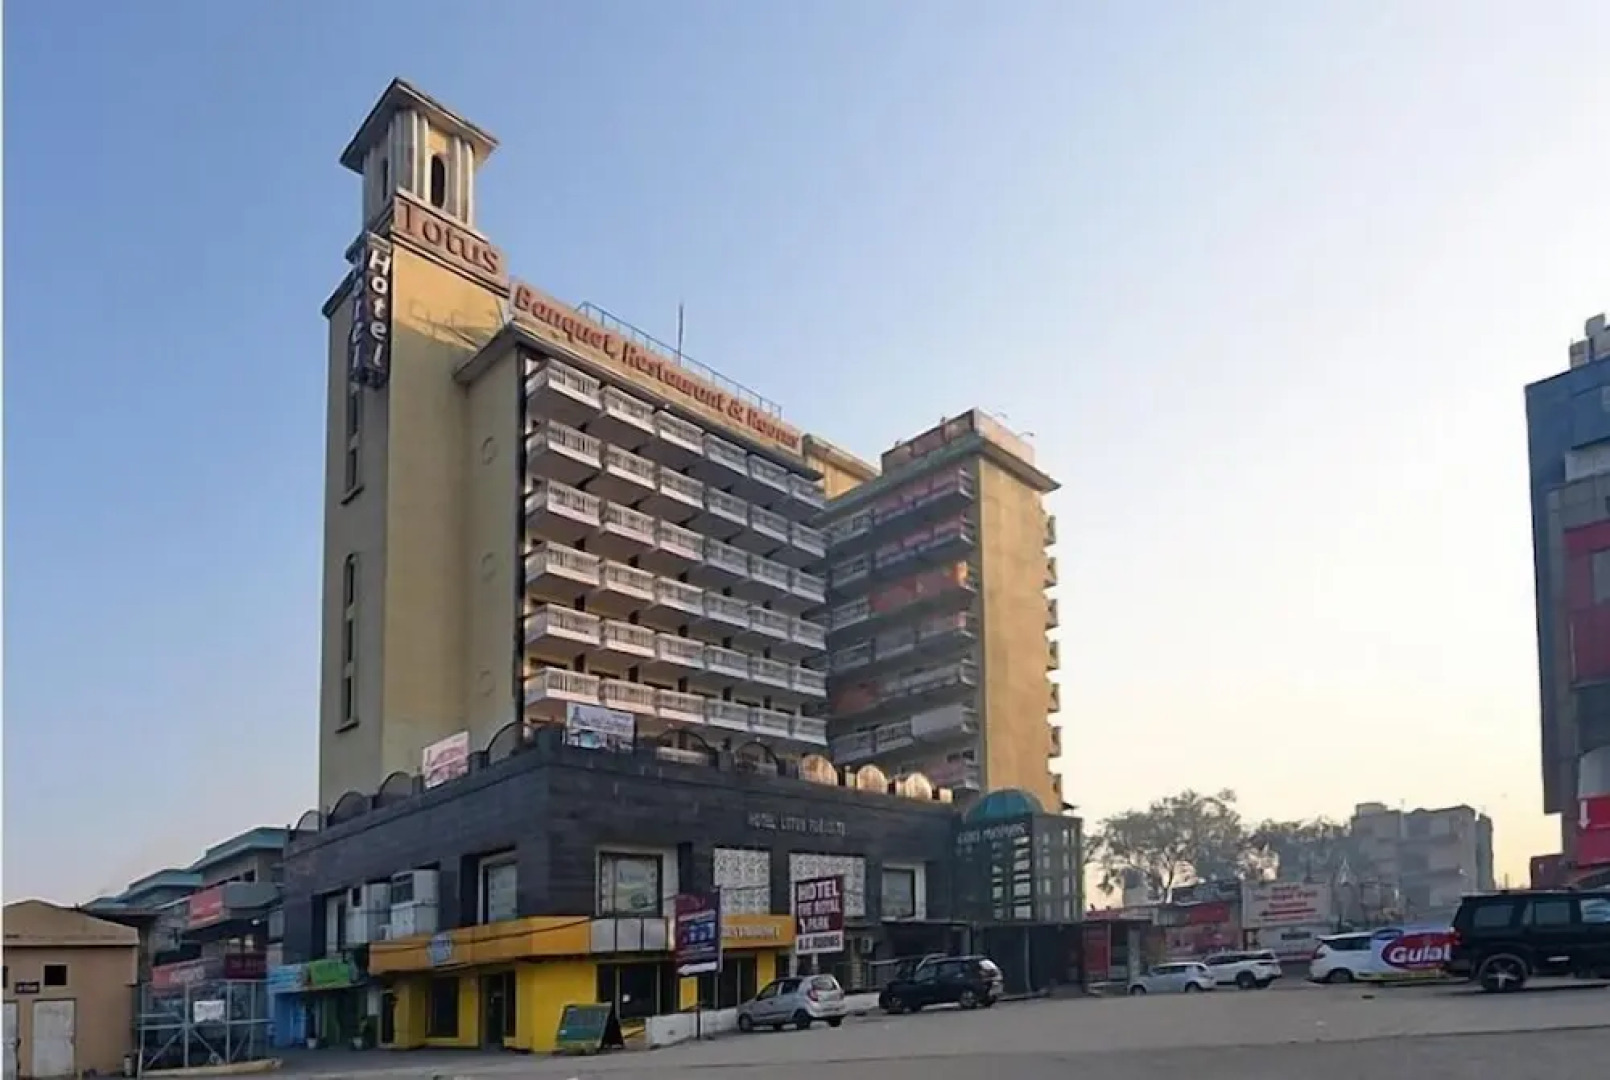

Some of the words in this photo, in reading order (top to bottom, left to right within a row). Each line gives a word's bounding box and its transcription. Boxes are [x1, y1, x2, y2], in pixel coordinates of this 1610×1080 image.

[369, 249, 391, 367] Hotel
[727, 398, 745, 423] &
[797, 879, 840, 901] HOTEL
